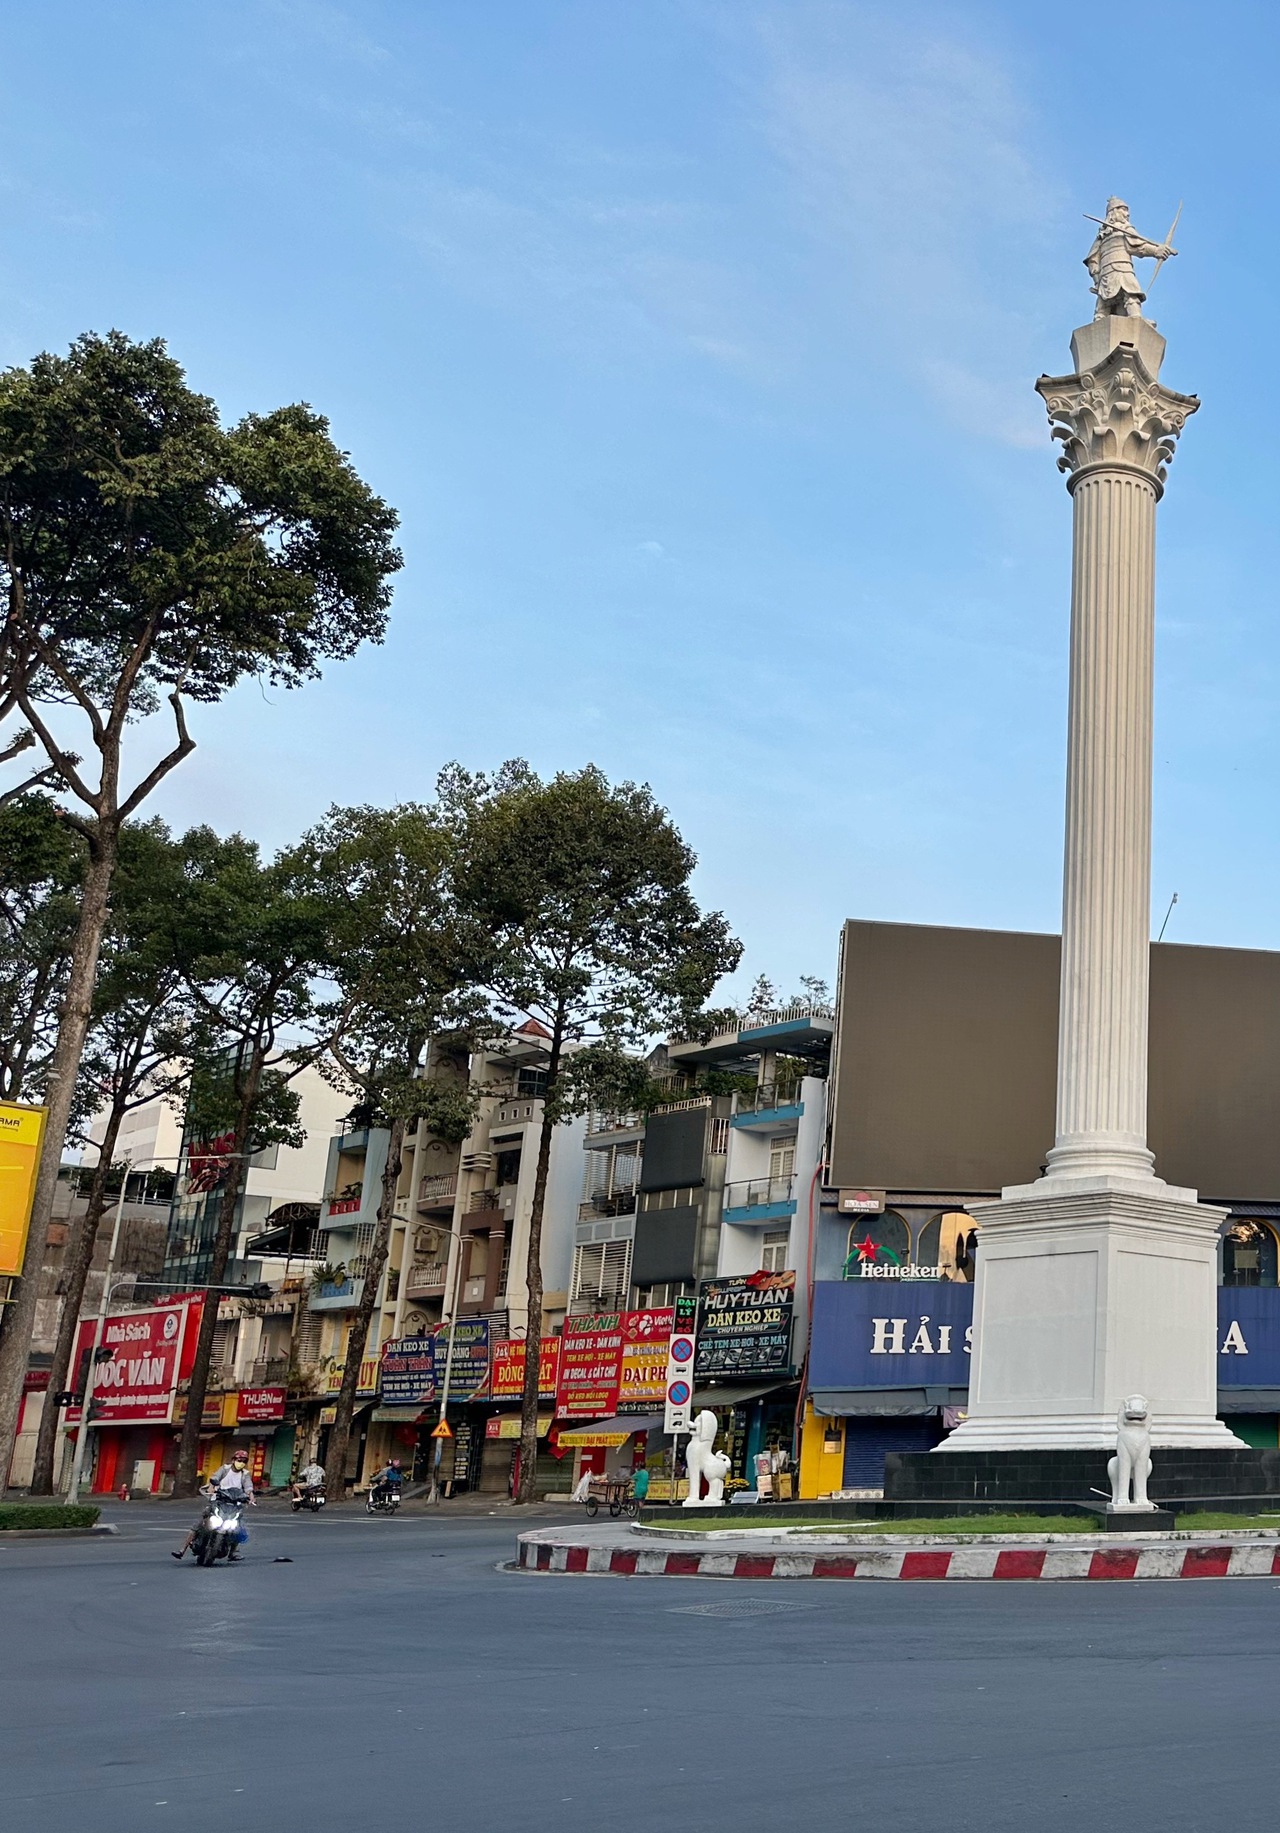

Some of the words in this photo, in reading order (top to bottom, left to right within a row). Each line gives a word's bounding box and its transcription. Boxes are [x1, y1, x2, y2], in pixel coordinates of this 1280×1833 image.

[861, 1263, 941, 1278] Heineken
[708, 1309, 734, 1327] DÁN
[736, 1310, 761, 1325] KEO
[763, 1308, 781, 1322] XE
[106, 1325, 126, 1343] Nhà
[125, 1321, 151, 1341] Sách
[870, 1316, 952, 1354] HẢI
[403, 1342, 417, 1351] KEO
[419, 1341, 429, 1350] XE
[714, 1340, 729, 1348] TEM
[730, 1339, 740, 1347] XE
[759, 1337, 769, 1345] XE
[128, 1351, 165, 1386] VĂN
[499, 1357, 524, 1382] ĐỒNG
[538, 1360, 552, 1380] ÁT
[623, 1367, 646, 1386] ĐẠI
[651, 1366, 667, 1381] PH
